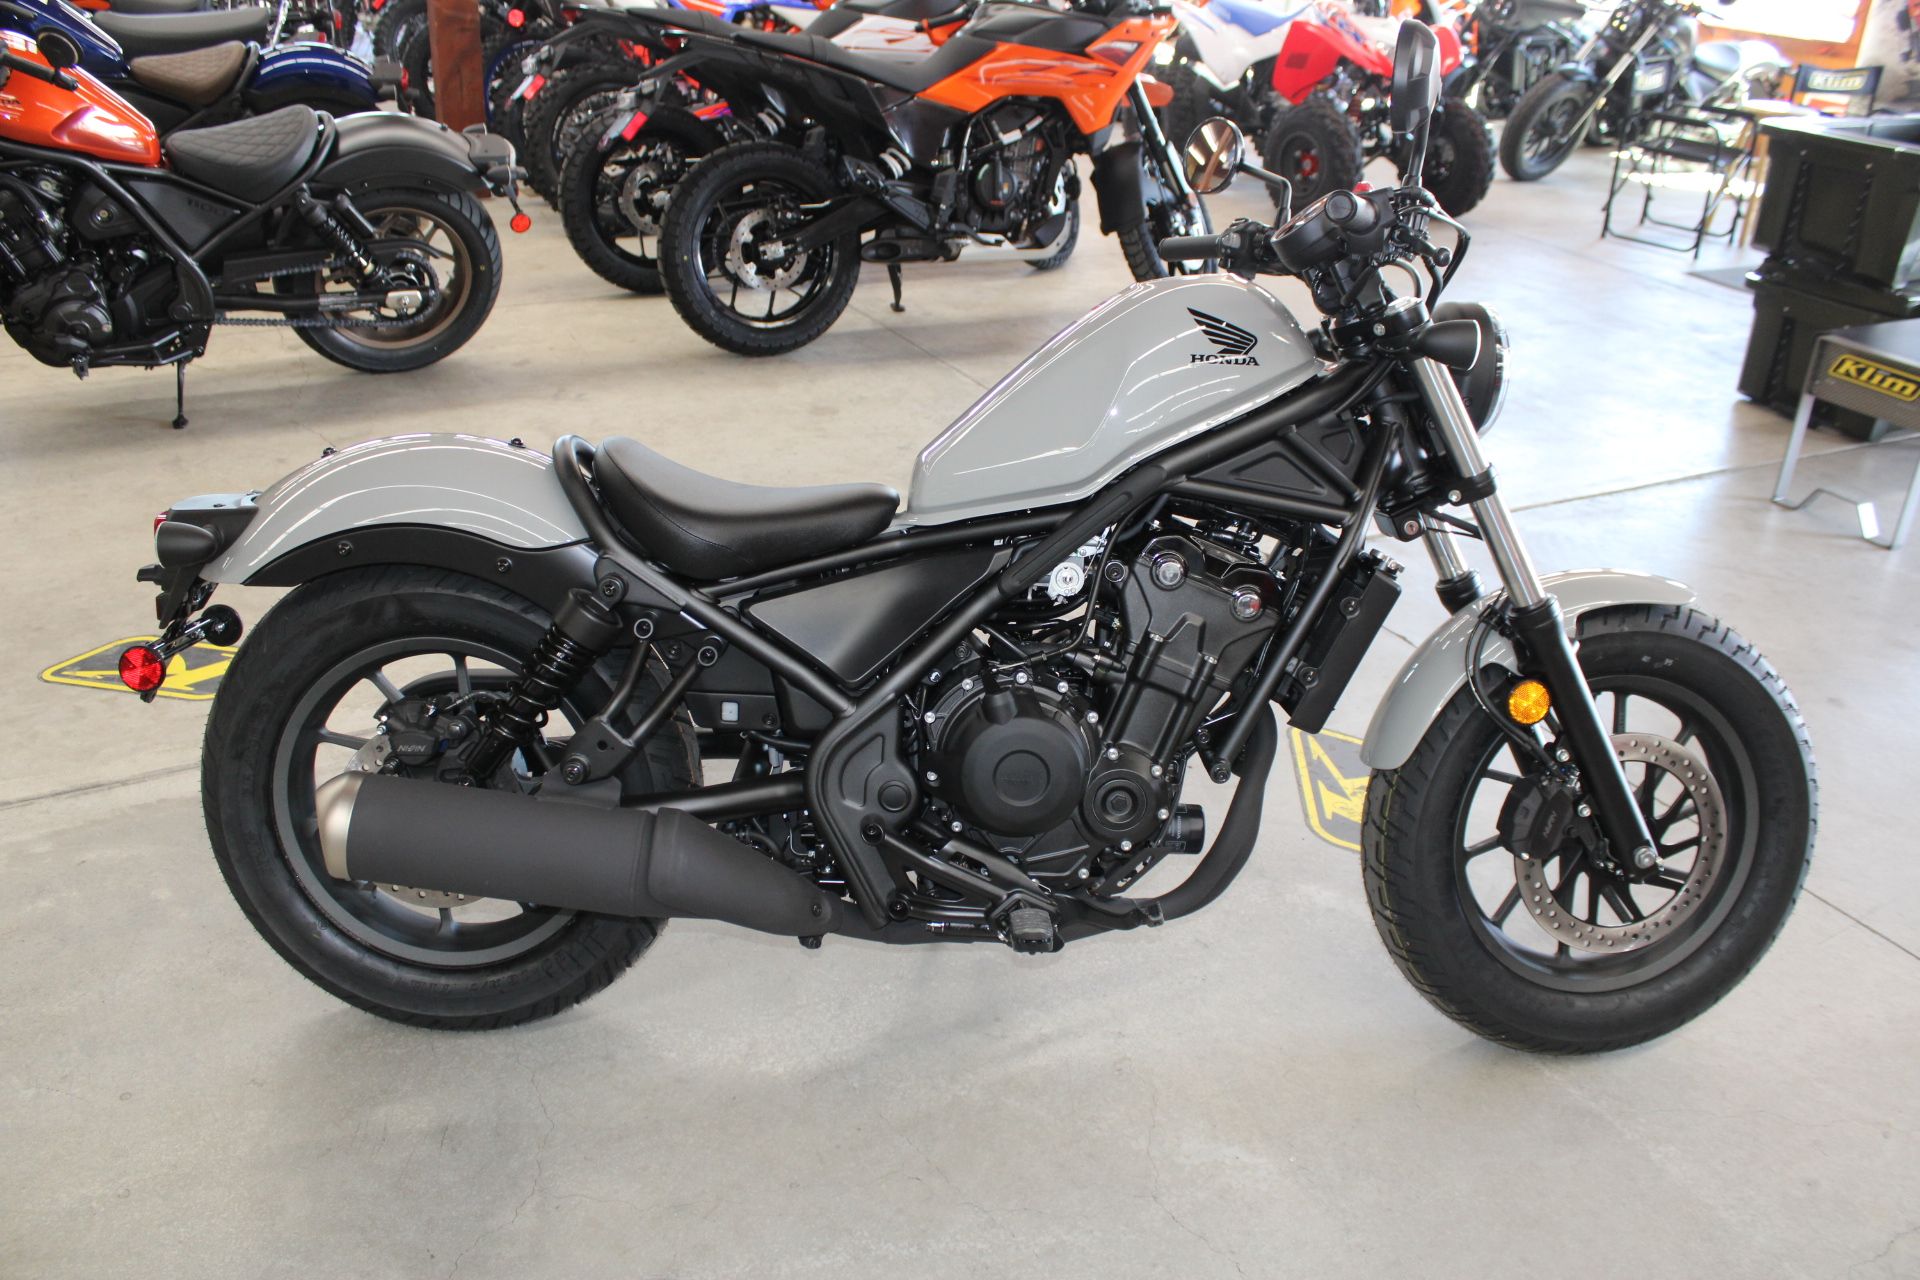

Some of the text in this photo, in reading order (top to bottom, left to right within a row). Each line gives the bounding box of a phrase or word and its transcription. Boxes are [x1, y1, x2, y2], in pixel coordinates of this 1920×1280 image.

[1810, 71, 1864, 89] Klim
[1190, 353, 1260, 367] HONDA
[1837, 359, 1919, 397] Klim
